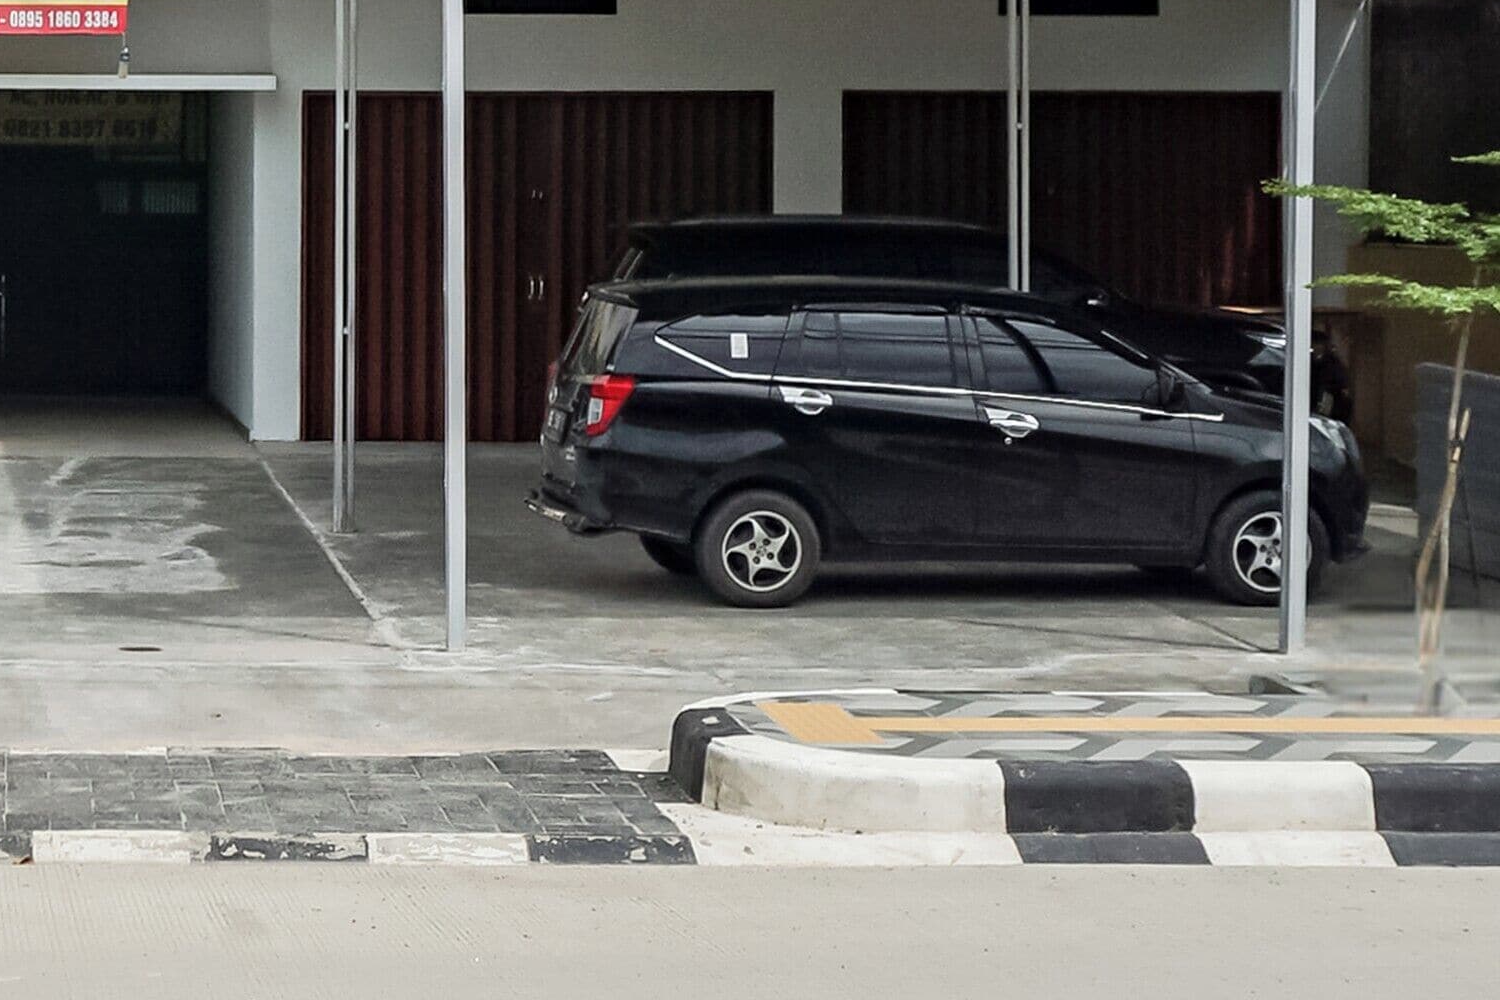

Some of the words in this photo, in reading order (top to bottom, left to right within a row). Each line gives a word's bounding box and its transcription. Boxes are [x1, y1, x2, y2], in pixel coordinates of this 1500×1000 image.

[10, 10, 43, 28] 0895
[47, 10, 81, 28] 1860
[84, 10, 119, 28] 3384
